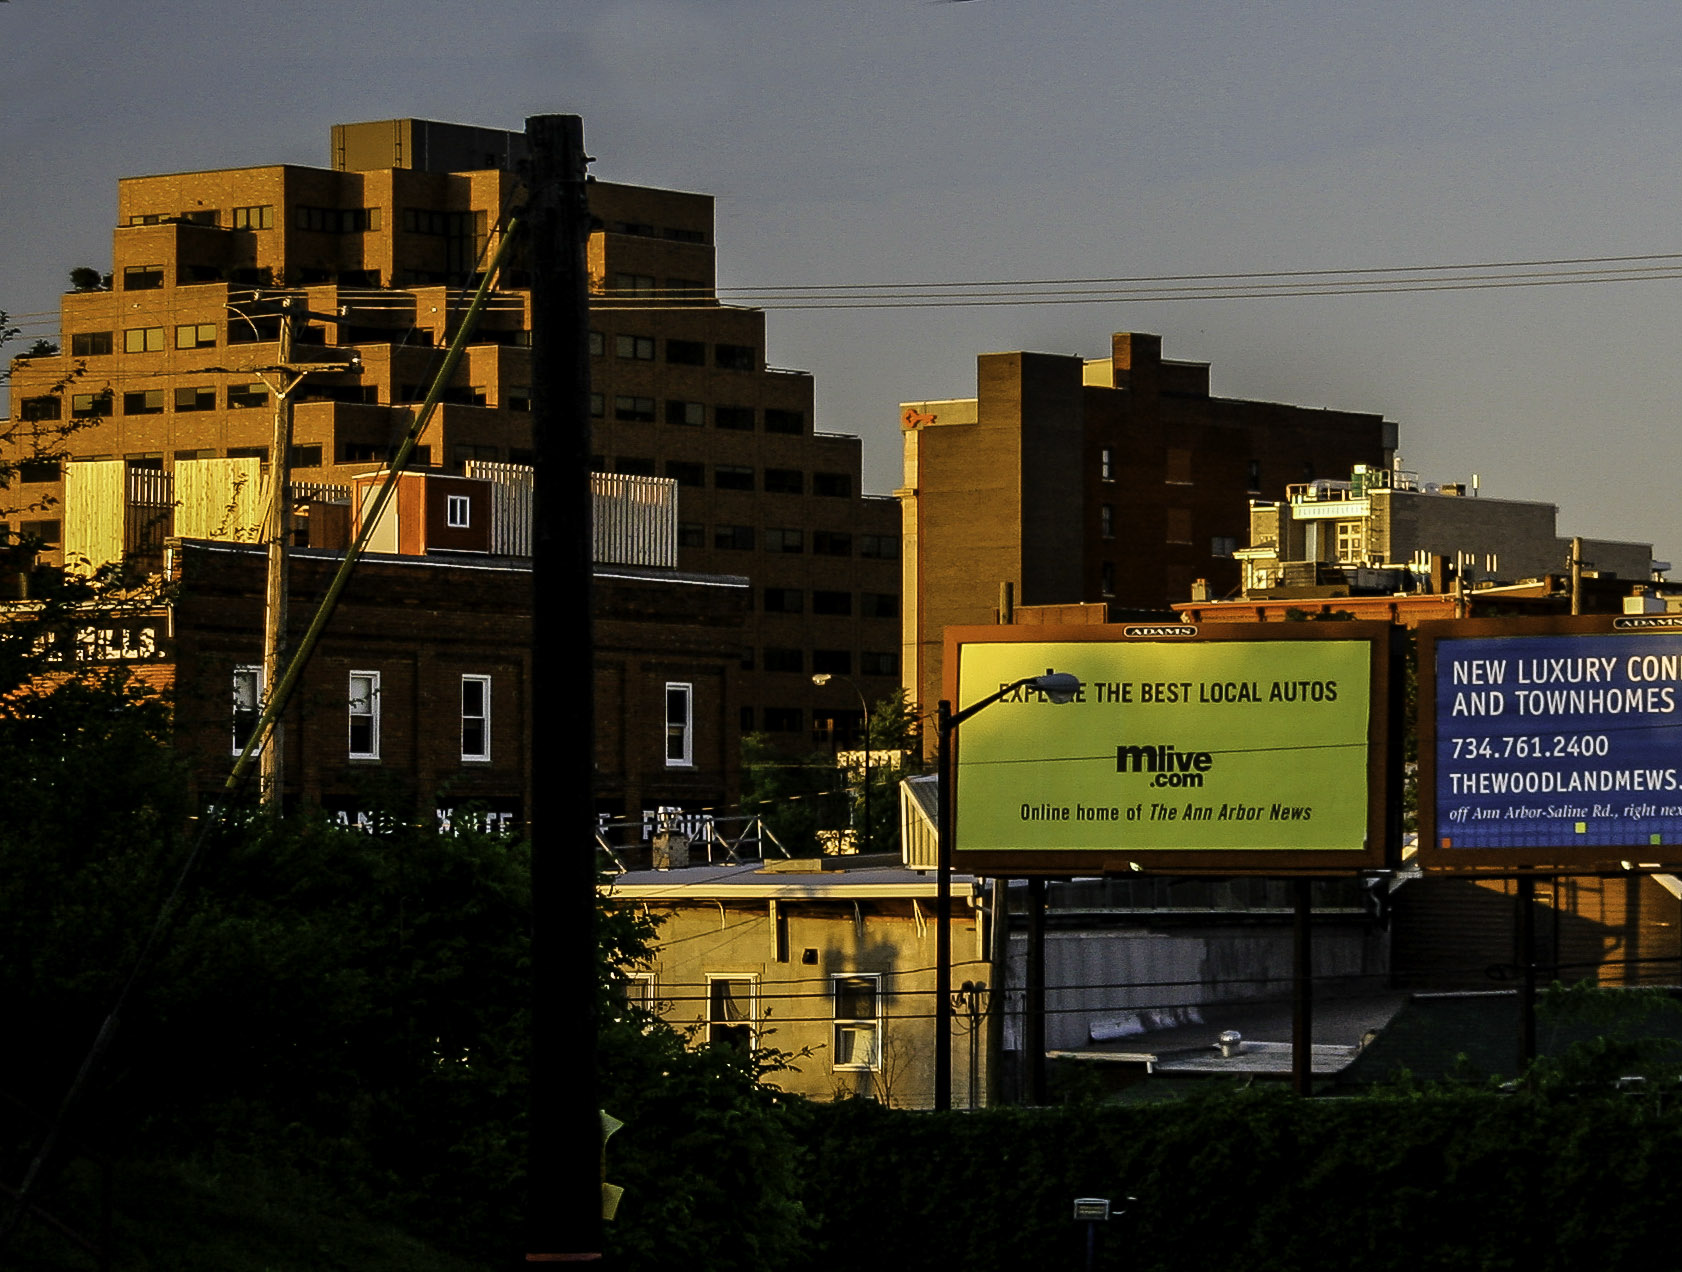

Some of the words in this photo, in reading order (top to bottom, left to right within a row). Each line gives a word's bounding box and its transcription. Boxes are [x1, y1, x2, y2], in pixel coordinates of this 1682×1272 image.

[1130, 627, 1191, 636] ADAMS
[1453, 660, 1506, 685] NEW
[1518, 657, 1617, 684] LUXURY
[1000, 682, 1086, 703] EXPLE
[1094, 683, 1134, 703] THE
[1141, 682, 1192, 703] BEST
[1200, 681, 1263, 703] LOCAL
[1269, 680, 1338, 702] AUTOS
[1453, 692, 1504, 716] AND
[1515, 687, 1675, 715] TOWNHOMES
[1452, 736, 1609, 758] 734.761.2400
[1116, 744, 1213, 773] mlive
[1150, 773, 1203, 788] .com
[1021, 804, 1070, 821] Online
[1076, 804, 1120, 821] home
[1127, 804, 1143, 820] of
[1149, 803, 1177, 820] The
[1182, 804, 1212, 820] Ann
[1218, 803, 1265, 820] Arbor
[1270, 803, 1313, 820] News
[1449, 807, 1469, 821] off
[1472, 806, 1500, 819] Ann
[1504, 804, 1588, 819] Arbor-Saline
[1592, 803, 1619, 819] Rd.,
[1623, 802, 1656, 821] right
